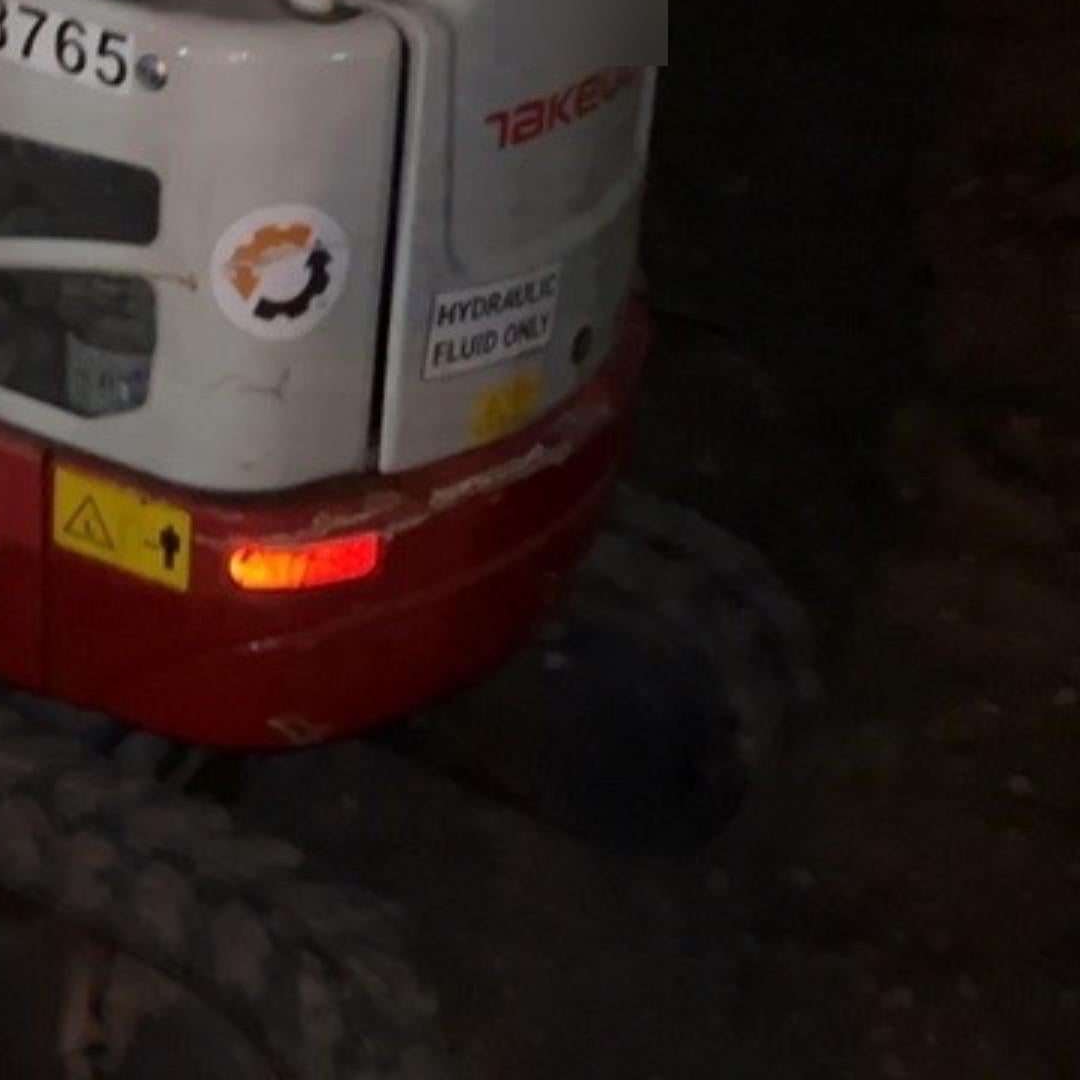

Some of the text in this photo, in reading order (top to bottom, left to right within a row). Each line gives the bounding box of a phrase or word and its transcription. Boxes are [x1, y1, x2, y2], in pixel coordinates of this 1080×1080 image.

[436, 272, 558, 328] HYDRAULIC
[431, 312, 549, 369] FLUID ONLY
